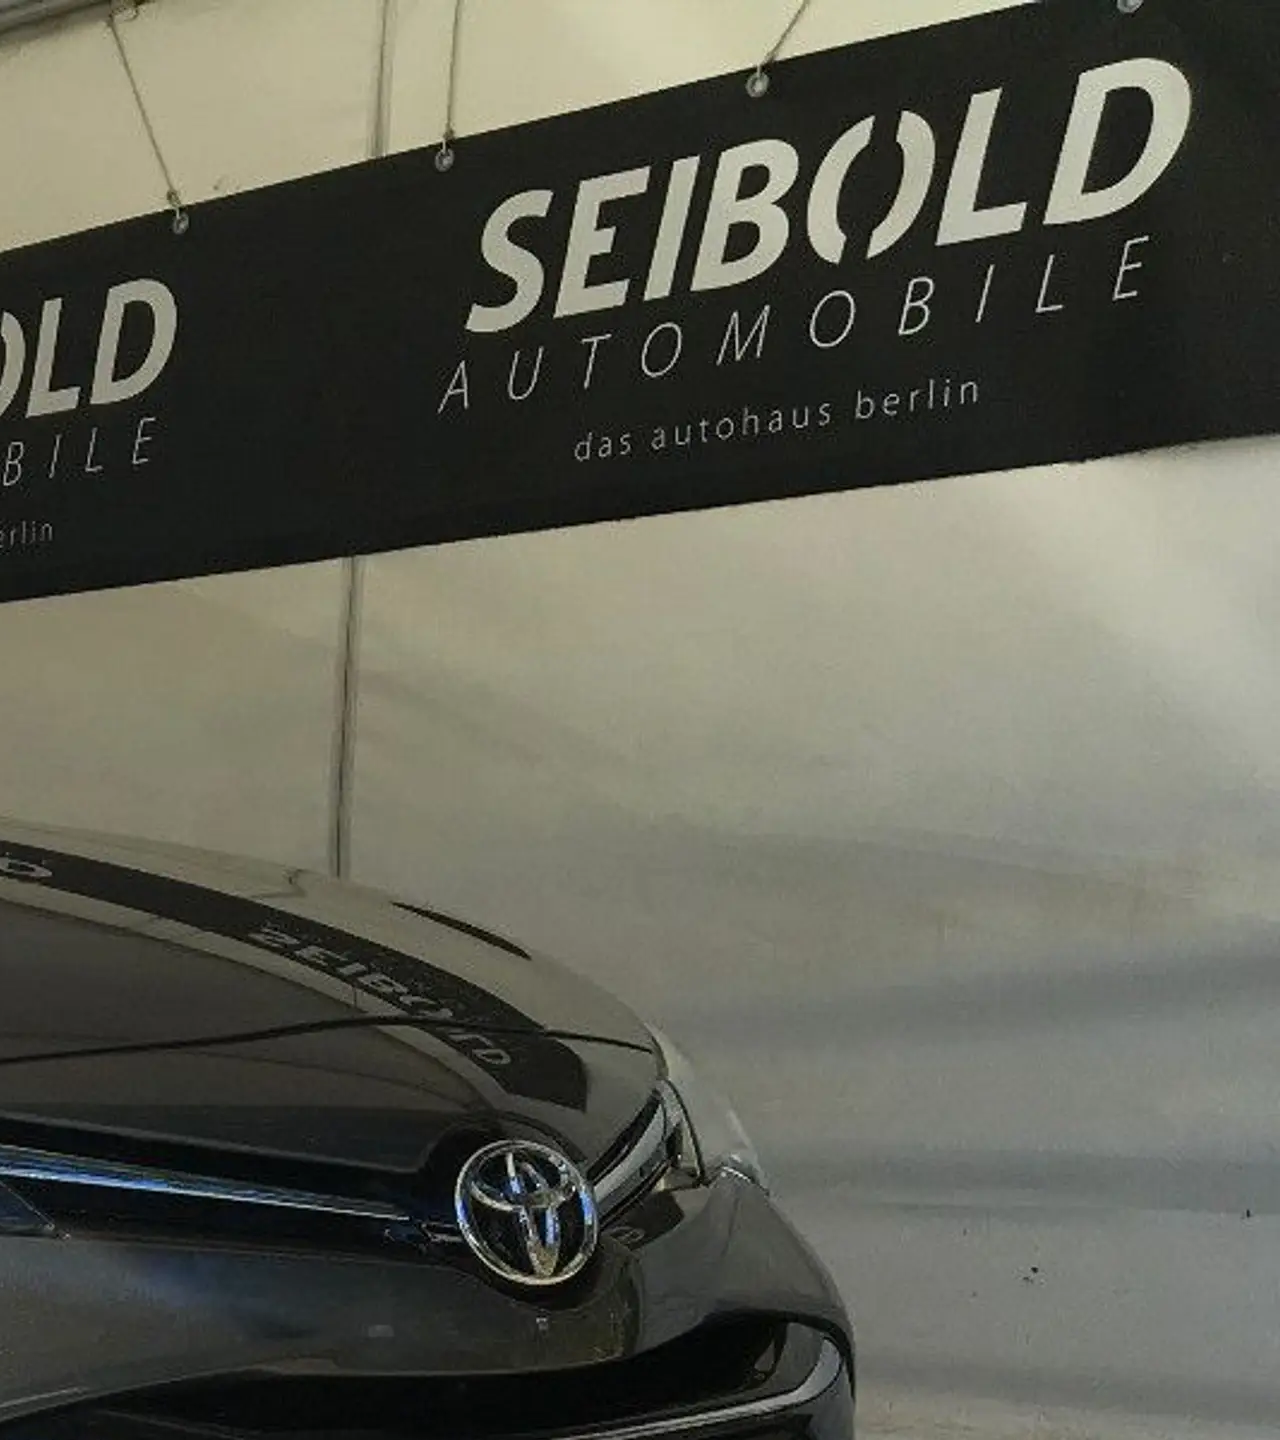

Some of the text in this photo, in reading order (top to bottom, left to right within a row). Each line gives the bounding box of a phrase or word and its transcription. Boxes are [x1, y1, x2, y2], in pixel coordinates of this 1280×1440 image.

[465, 57, 1192, 334] SEIBOLD
[438, 235, 1150, 413] AUTOMOBILE
[574, 377, 980, 462] das autohaus berlin
